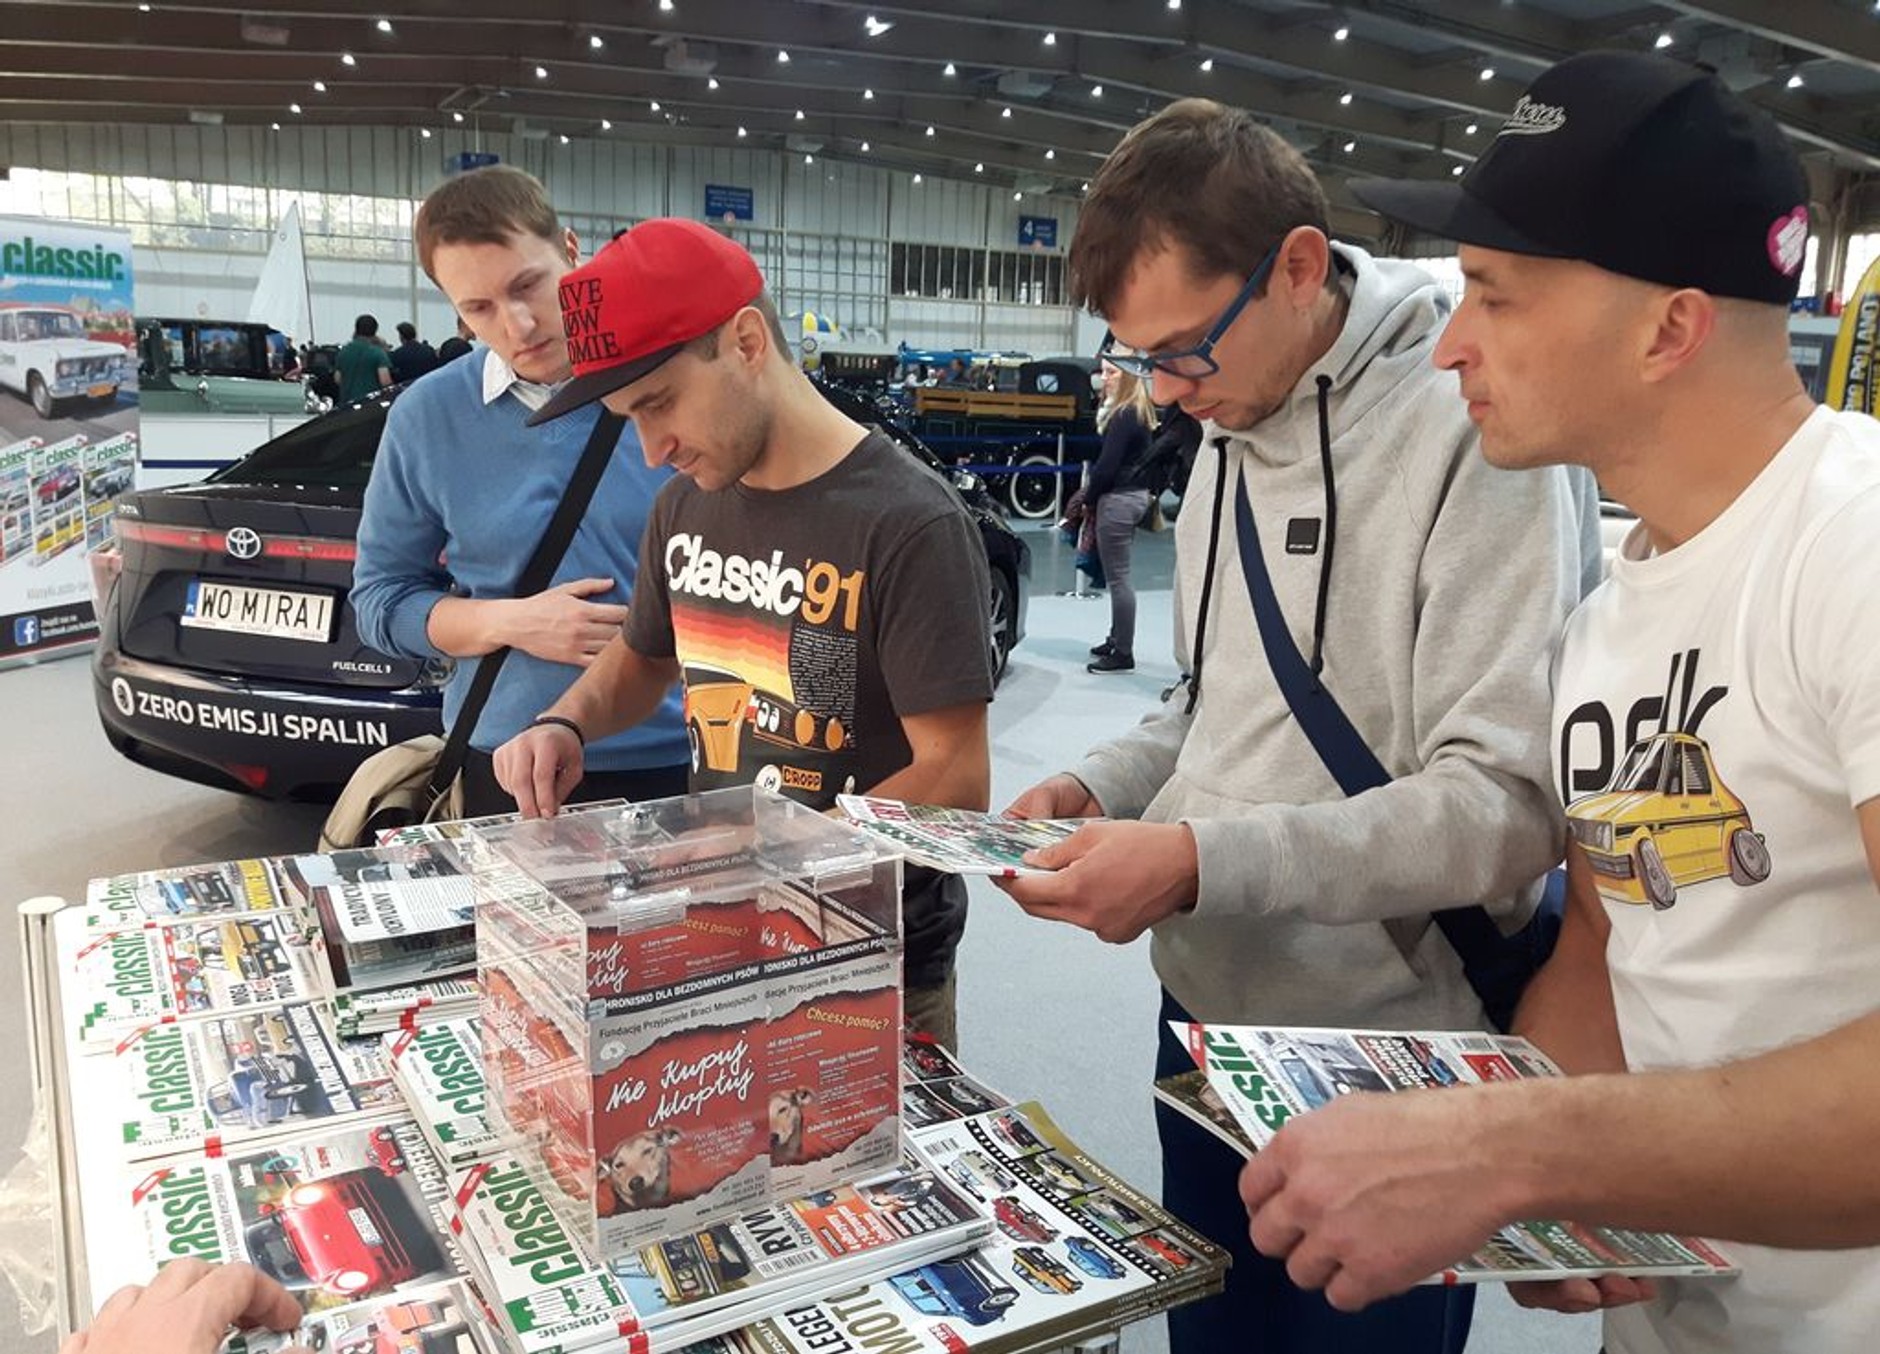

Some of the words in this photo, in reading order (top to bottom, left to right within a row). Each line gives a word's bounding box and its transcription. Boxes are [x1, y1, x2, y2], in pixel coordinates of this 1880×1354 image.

[3, 236, 124, 281] classic
[559, 278, 603, 312] IVE
[568, 331, 623, 364] OMIE
[241, 590, 326, 631] MIRAI
[665, 532, 804, 616] Classic
[801, 558, 865, 632] '91
[137, 691, 195, 725] ZERO
[199, 703, 279, 737] EMISJI
[284, 715, 389, 747] SPALIN
[783, 769, 822, 789] CROPP
[105, 930, 154, 997] classic
[604, 994, 653, 1010] HRONISKO
[656, 988, 673, 1001] DLA
[674, 973, 734, 996] BEZDOMNYCH
[799, 956, 815, 966] DLA
[806, 1006, 844, 1025] Chcesz
[845, 1014, 890, 1031] pomóc?
[133, 1026, 195, 1114] classic
[409, 1024, 486, 1115] classic
[606, 1076, 648, 1113] Nie
[661, 1030, 748, 1089] Kupuj
[648, 1059, 755, 1128] Adoptuj
[1204, 1030, 1292, 1131] ssic
[395, 1120, 446, 1192] PERFEKCJA
[148, 1165, 223, 1264] lassic
[476, 1160, 586, 1285] classic
[784, 1303, 853, 1354] LEGE
[822, 1285, 926, 1354] MOT
